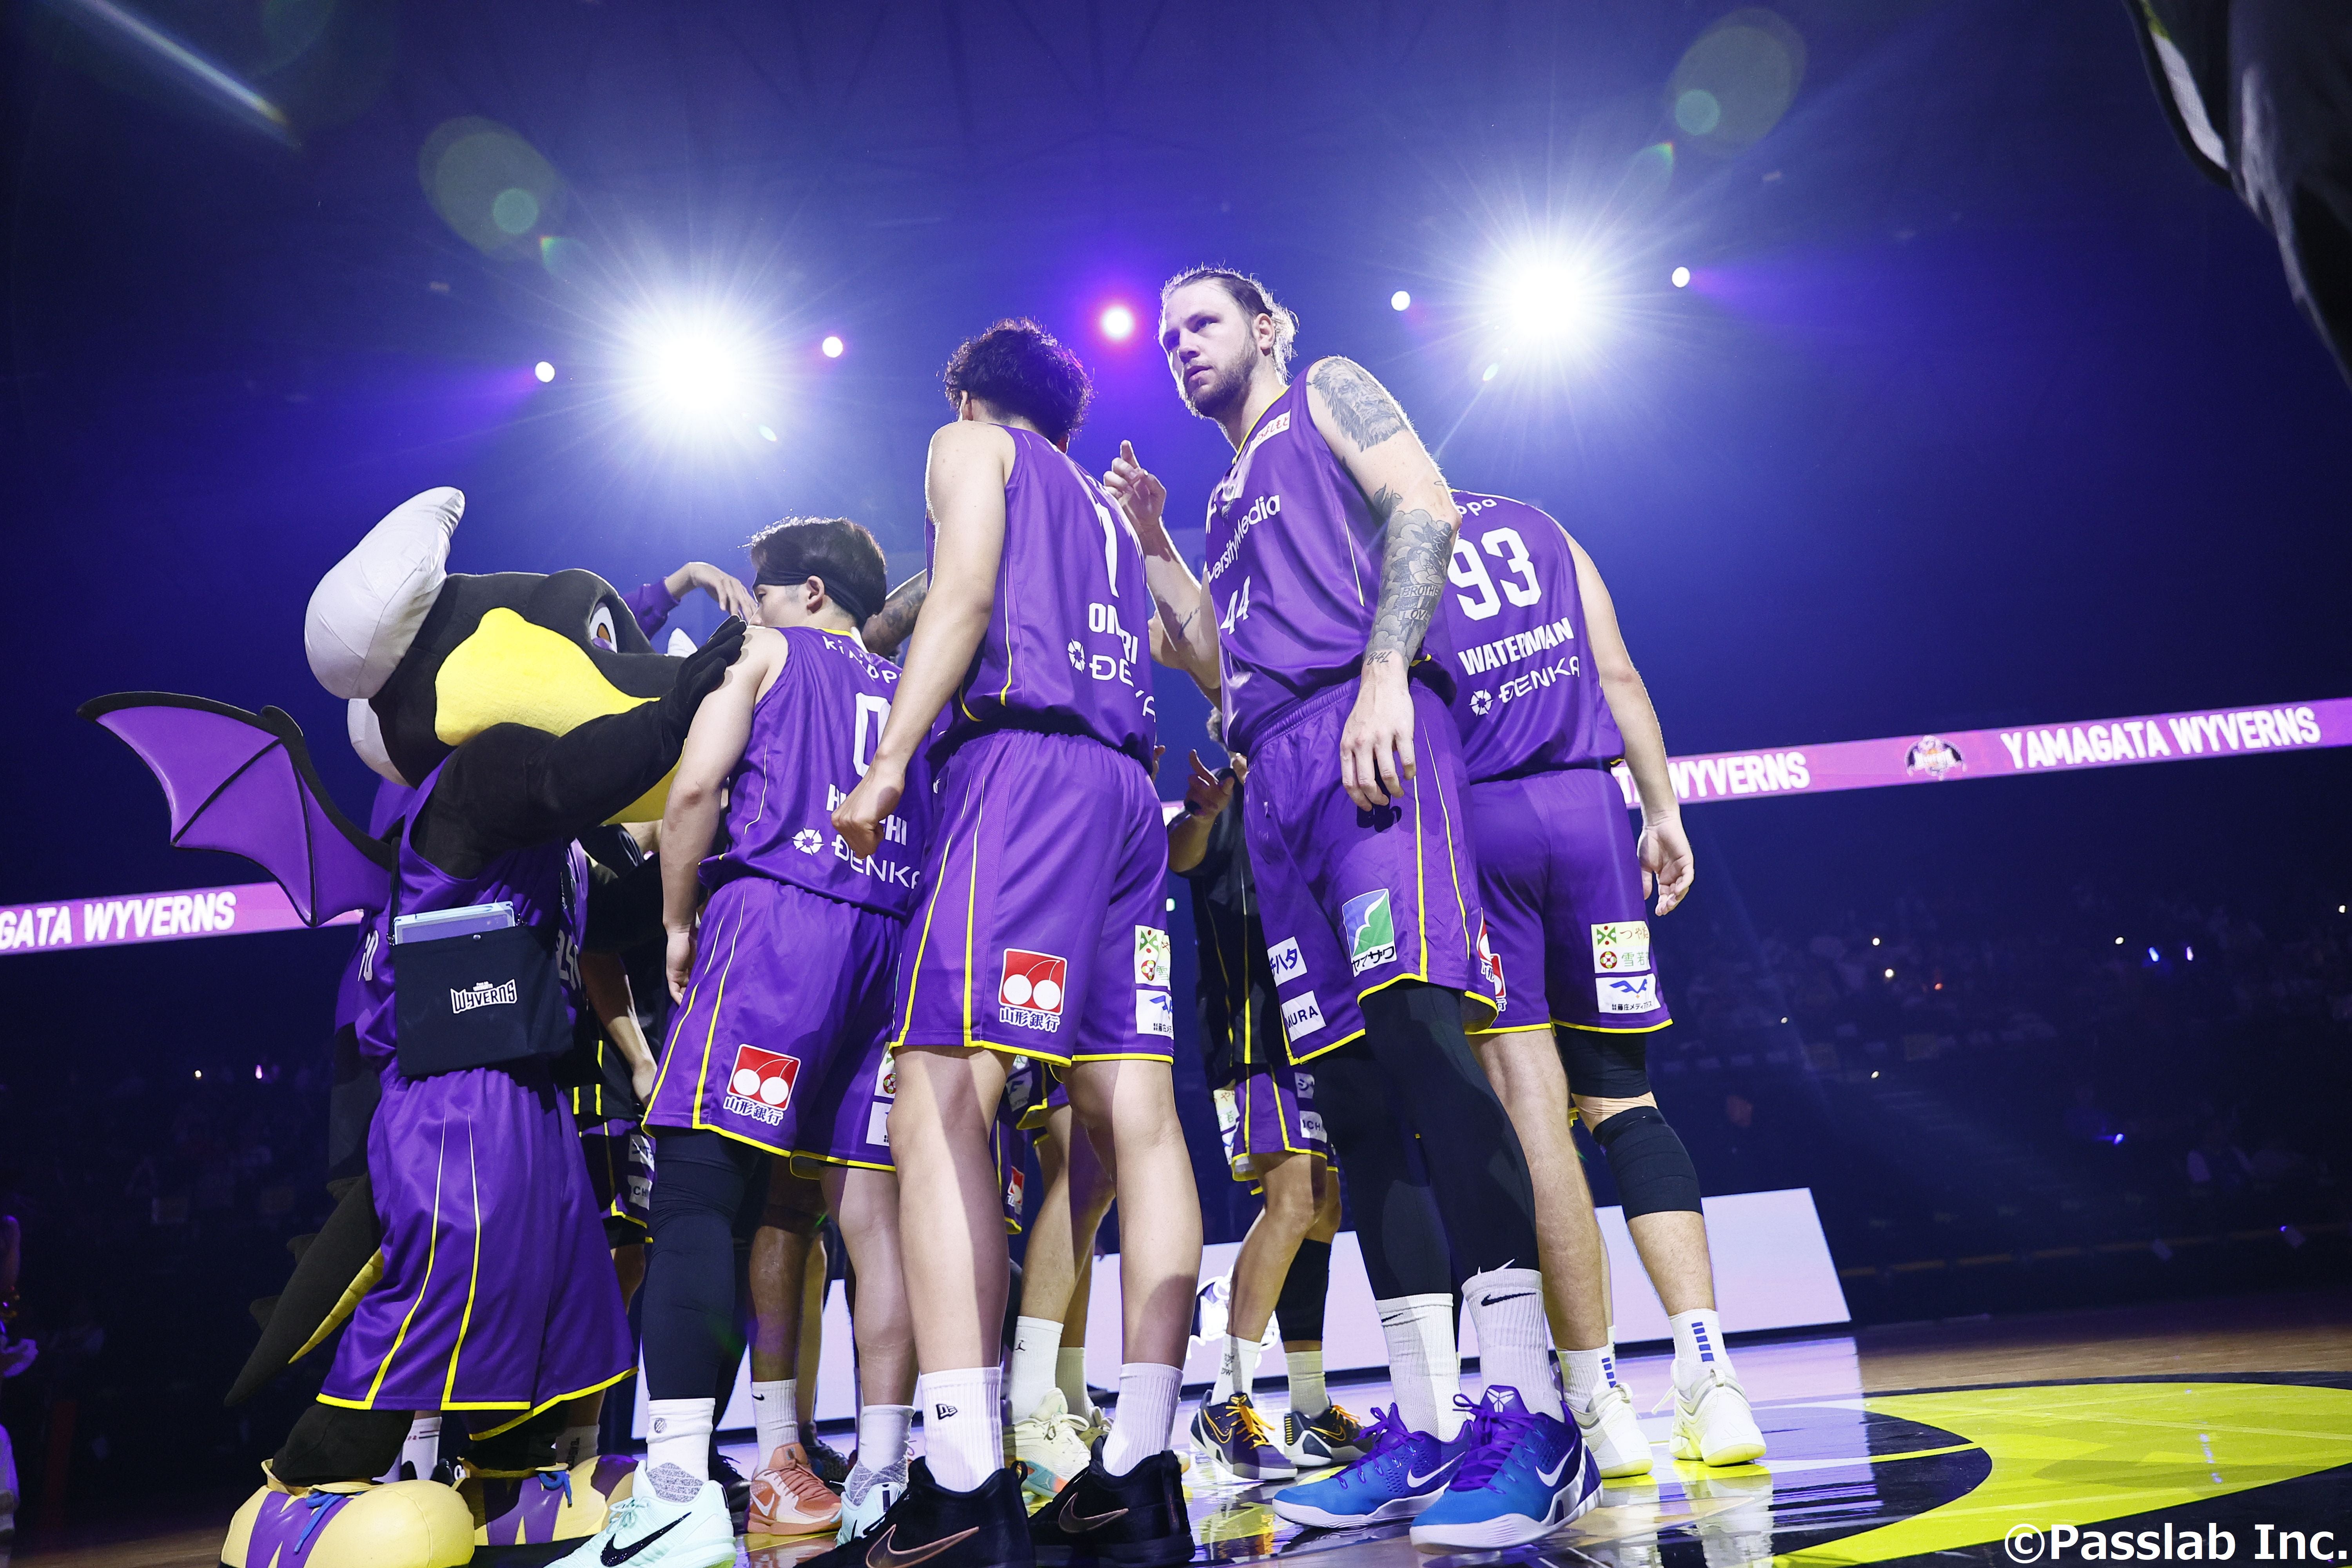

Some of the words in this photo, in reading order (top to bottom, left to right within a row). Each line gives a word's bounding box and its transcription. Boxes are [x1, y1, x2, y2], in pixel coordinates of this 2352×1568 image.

[1448, 527, 1542, 621] 93
[1220, 575, 1250, 635] 44
[1499, 655, 1581, 703] DENKA
[2000, 720, 2171, 769] YAMAGATA
[2168, 707, 2321, 754] WYVERNS
[0, 906, 72, 950] GATA
[84, 891, 236, 942] WYVERNS
[1000, 1007, 1060, 1033] 山形銀行
[723, 1096, 784, 1126] 山形銀行
